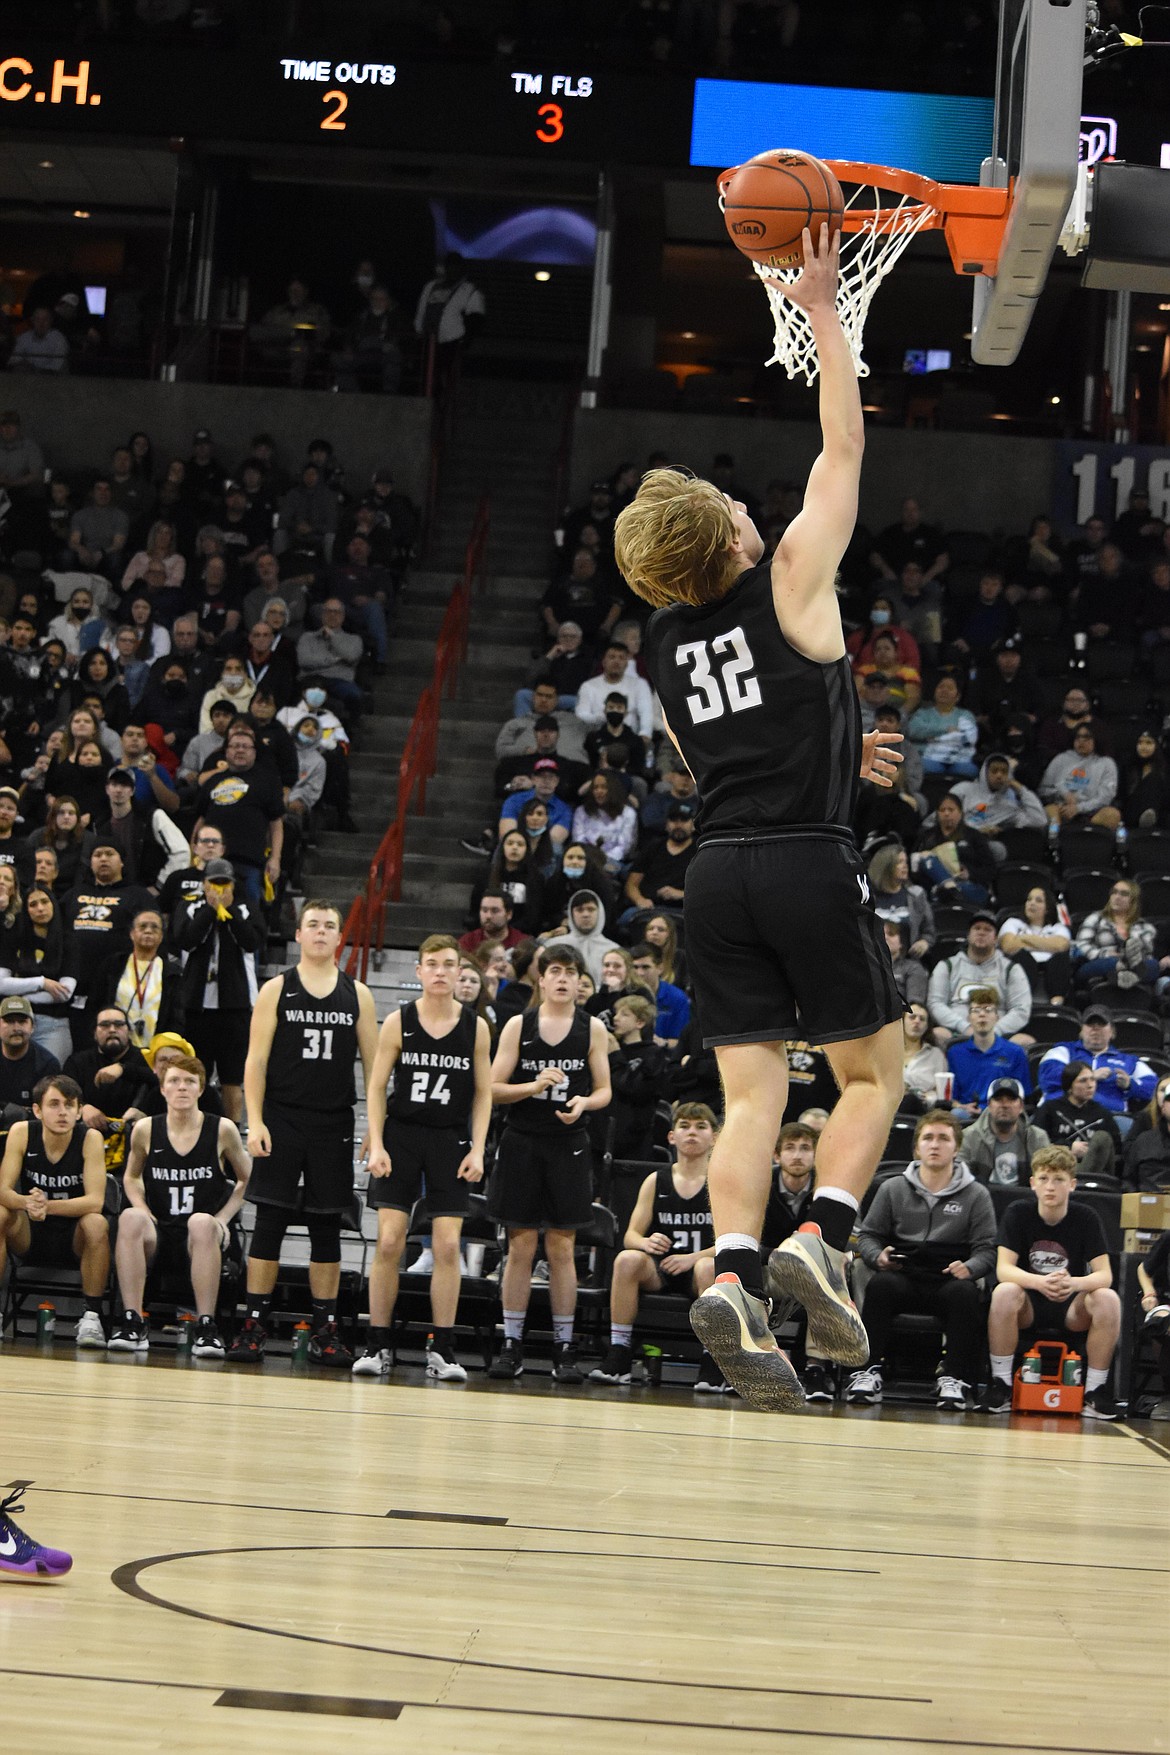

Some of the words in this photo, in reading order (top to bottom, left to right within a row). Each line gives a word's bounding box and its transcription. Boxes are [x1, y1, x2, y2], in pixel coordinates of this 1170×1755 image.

[0, 57, 101, 105] C.H.
[280, 59, 331, 81] TIME
[335, 62, 396, 85] OUTS
[511, 72, 542, 94] TM
[551, 75, 593, 97] FLS
[320, 90, 348, 130] 2
[536, 103, 564, 143] 3
[675, 626, 763, 725] 32
[285, 1009, 354, 1026] WARRIORS
[302, 1028, 334, 1060] 31
[401, 1051, 471, 1071] WARRIORS
[521, 1058, 585, 1071] WARRIORS
[410, 1071, 451, 1105] 24
[152, 1166, 213, 1181] WARRIORS
[168, 1186, 195, 1215] 15
[942, 1203, 963, 1213] ACH
[658, 1211, 713, 1225] WARRIOR
[1043, 1389, 1061, 1408] G
